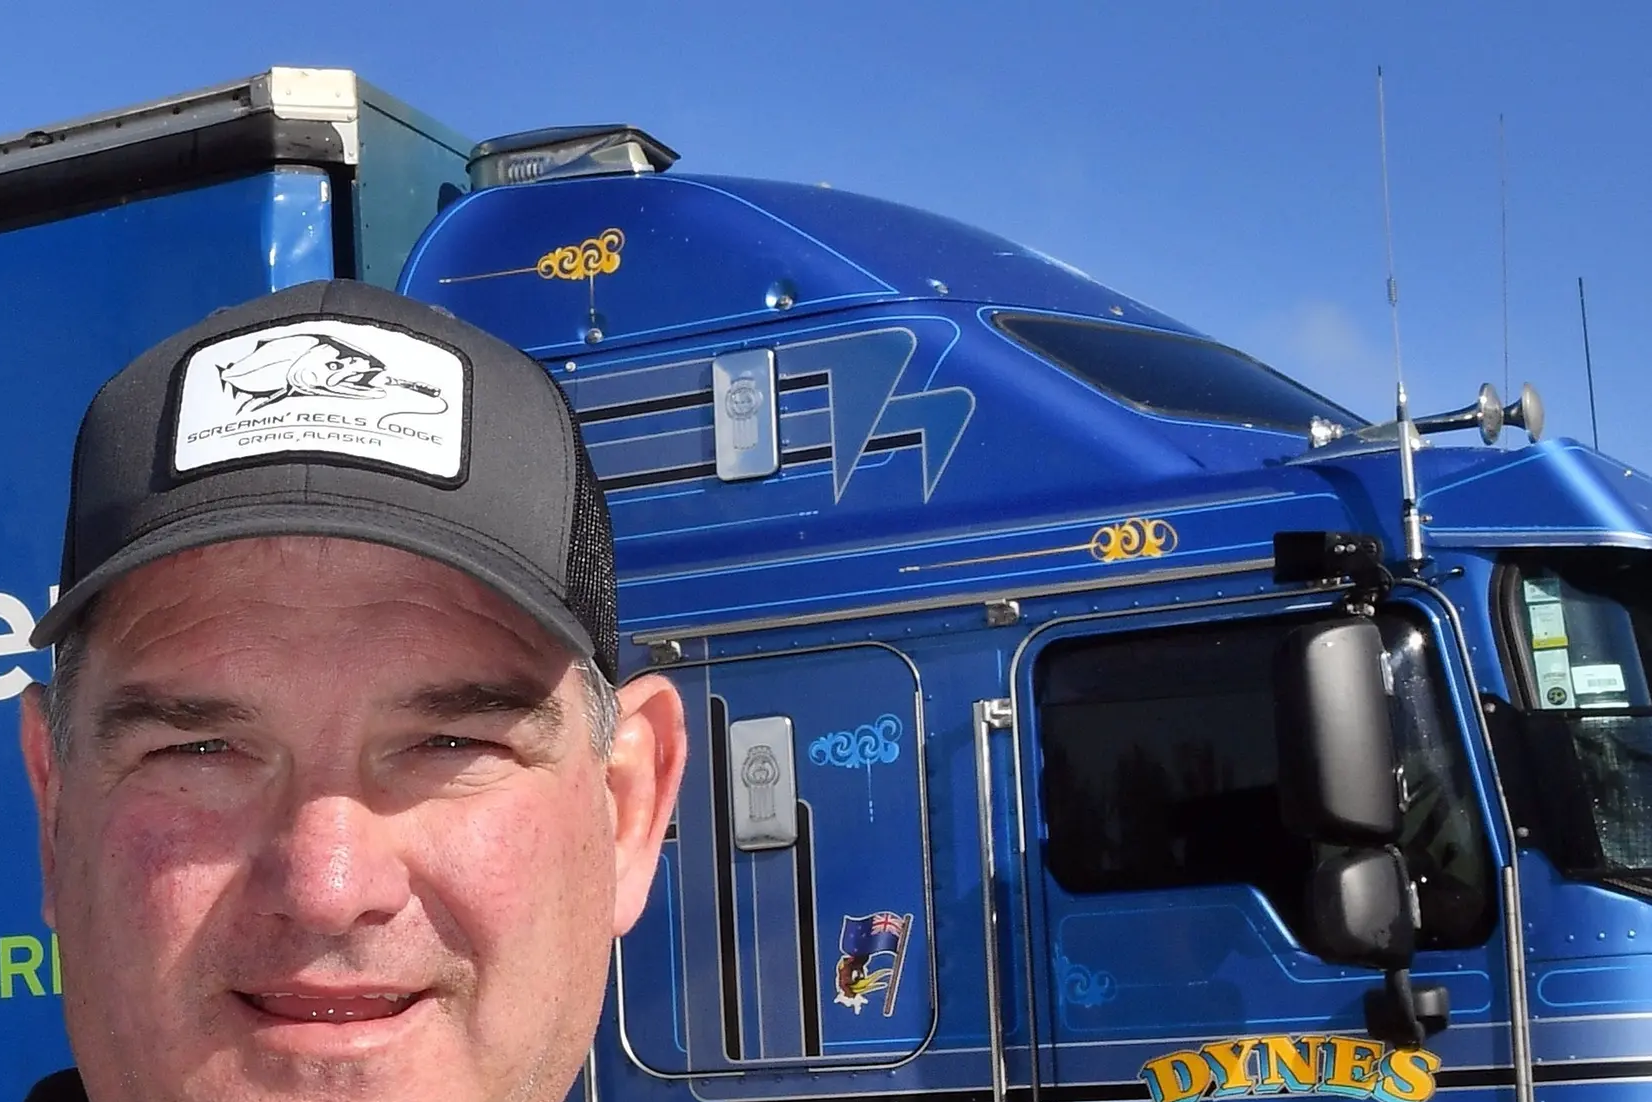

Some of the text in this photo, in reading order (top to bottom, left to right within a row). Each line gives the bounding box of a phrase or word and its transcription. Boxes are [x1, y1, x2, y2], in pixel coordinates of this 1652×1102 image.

[187, 411, 443, 446] SCREAMIN' REELS LODGE
[302, 431, 382, 447] ALASKA
